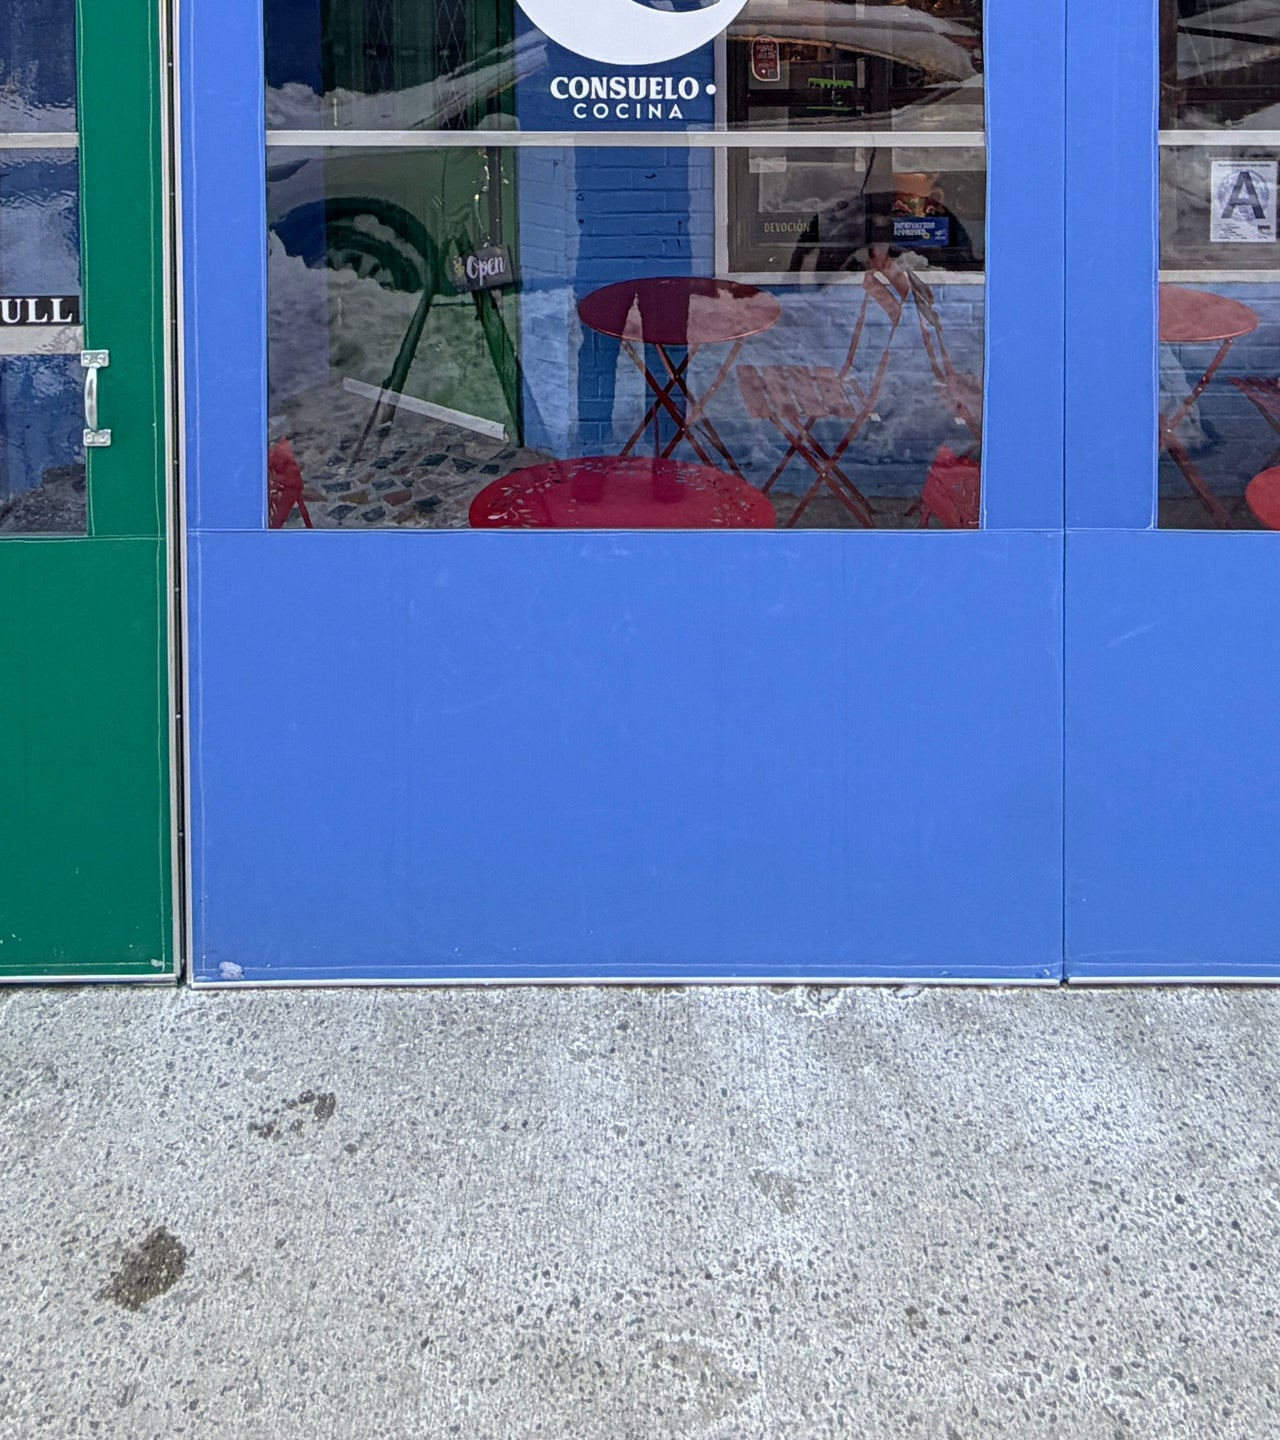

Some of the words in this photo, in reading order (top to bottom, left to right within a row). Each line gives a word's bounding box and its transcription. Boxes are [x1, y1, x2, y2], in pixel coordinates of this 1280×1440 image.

[550, 76, 700, 100] CONSUELO
[573, 103, 683, 119] COCINA
[1221, 171, 1267, 220] A
[763, 219, 811, 233] DEVOCIÓN
[466, 255, 506, 287] Open
